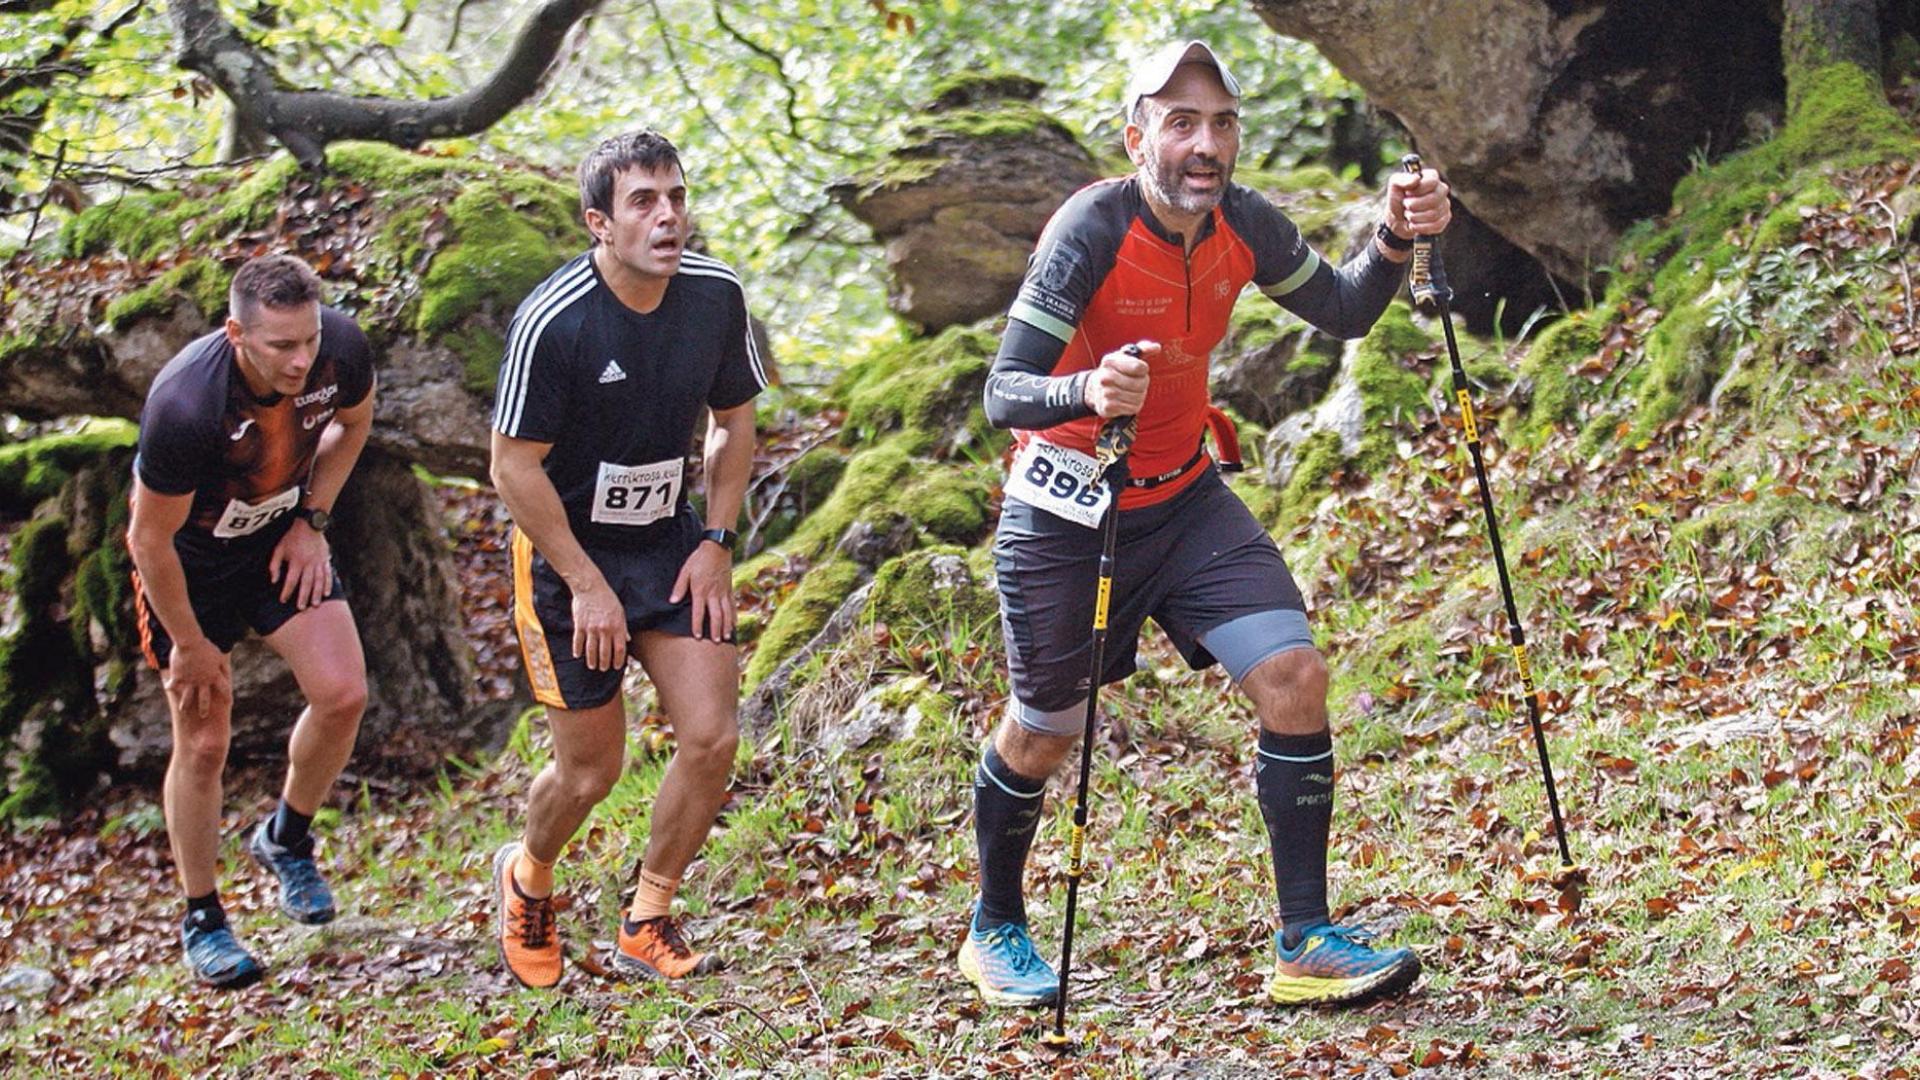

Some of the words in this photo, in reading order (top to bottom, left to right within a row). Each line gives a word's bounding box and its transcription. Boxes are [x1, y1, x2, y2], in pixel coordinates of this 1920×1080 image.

[605, 481, 672, 510] 871
[1025, 456, 1104, 507] 896
[228, 506, 288, 530] 870
